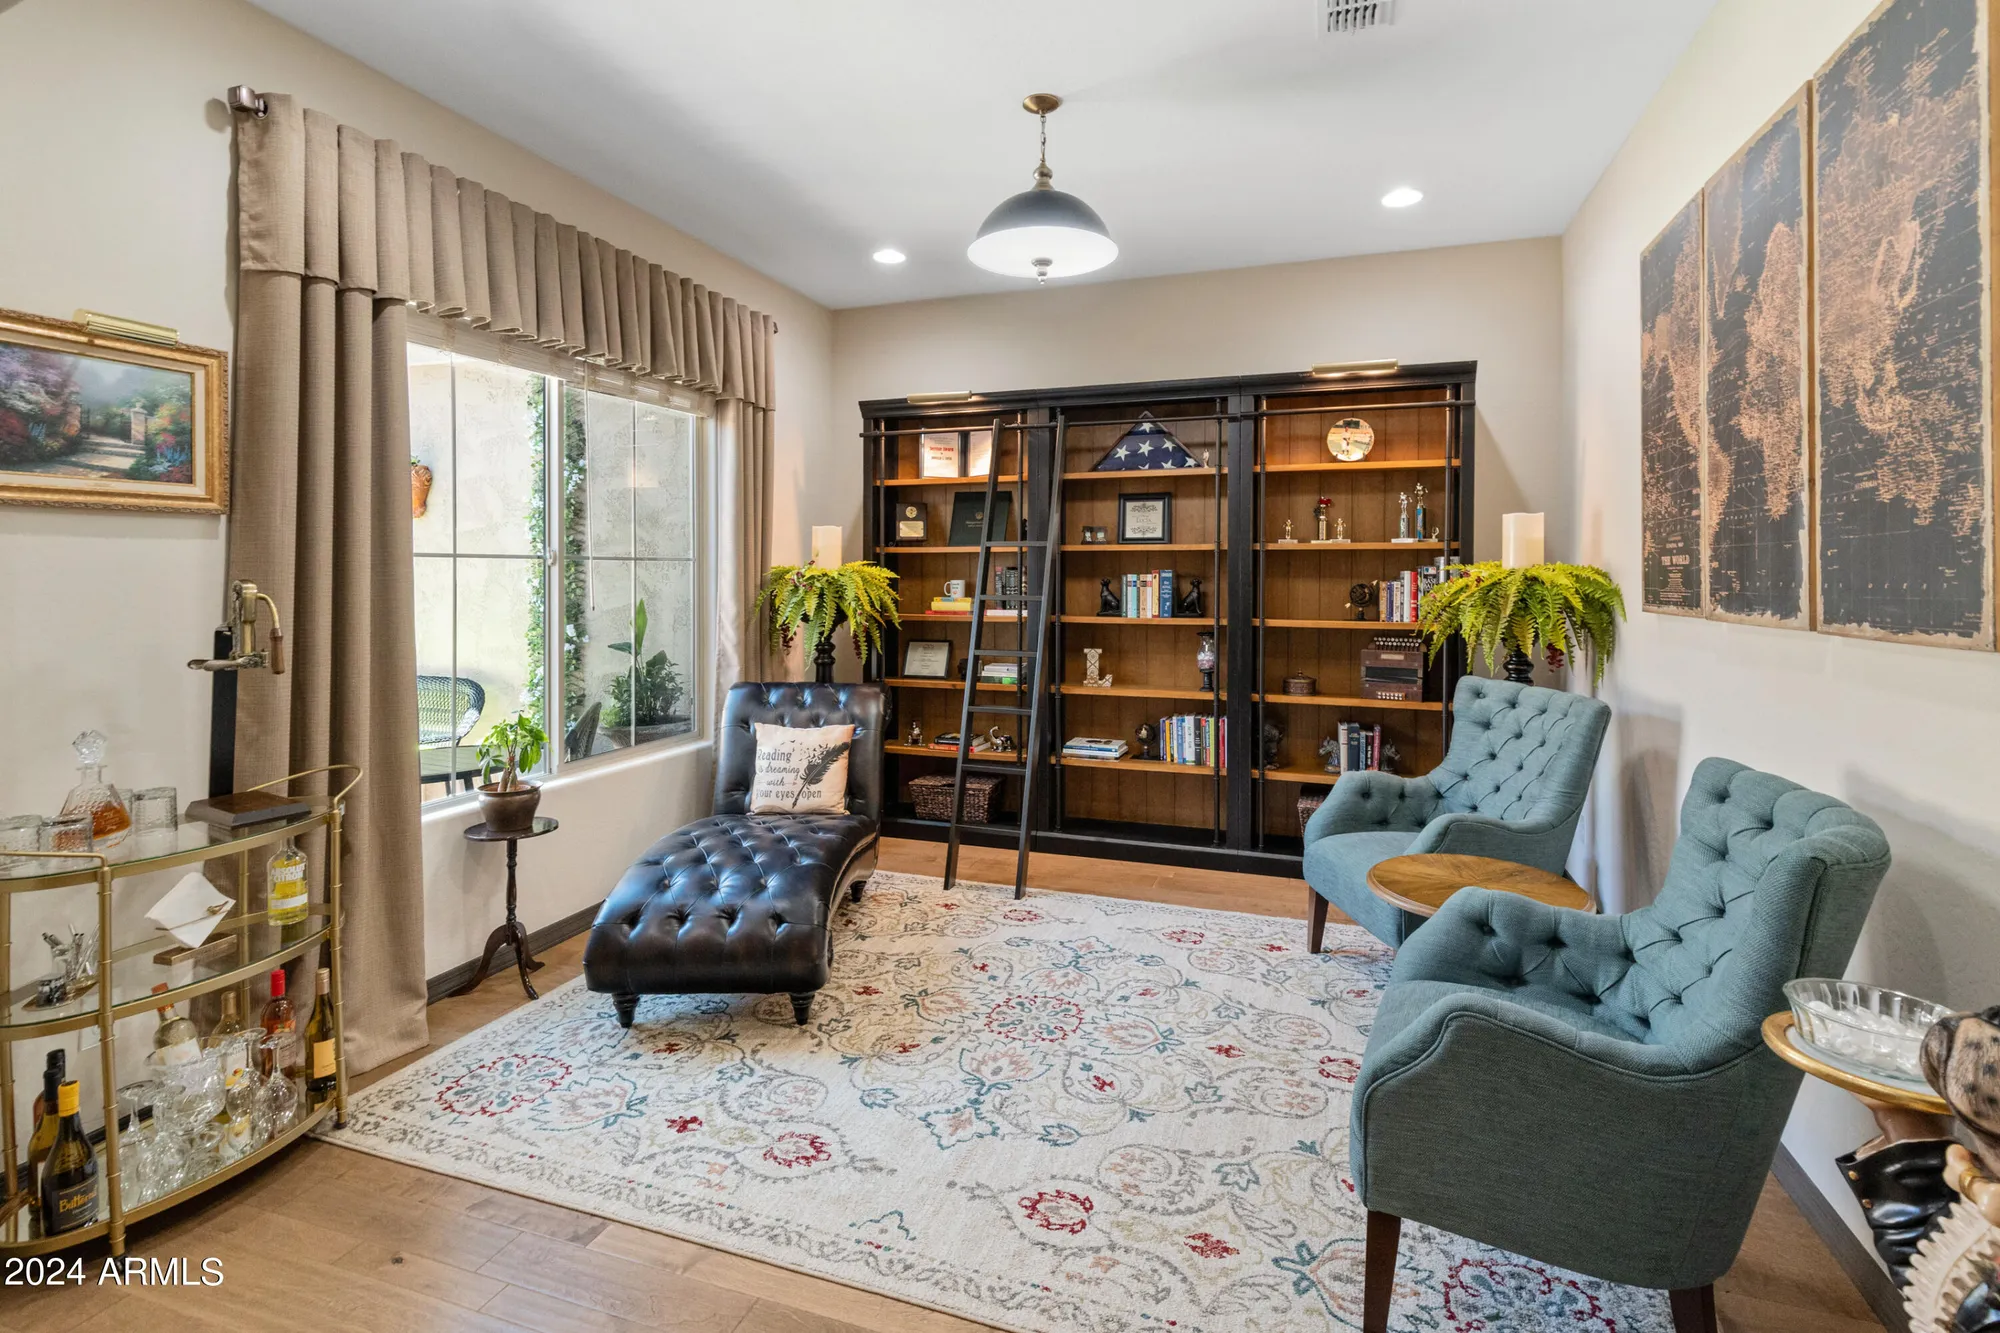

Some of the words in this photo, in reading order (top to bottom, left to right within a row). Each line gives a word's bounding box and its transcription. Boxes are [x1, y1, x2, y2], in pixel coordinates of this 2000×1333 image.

[757, 748, 793, 763] Reading
[765, 761, 801, 780] dreaming
[766, 777, 785, 787] with
[775, 790, 795, 801] eyes
[801, 790, 822, 801] open
[271, 862, 307, 876] ABSOLUT
[273, 871, 304, 882] CITRON
